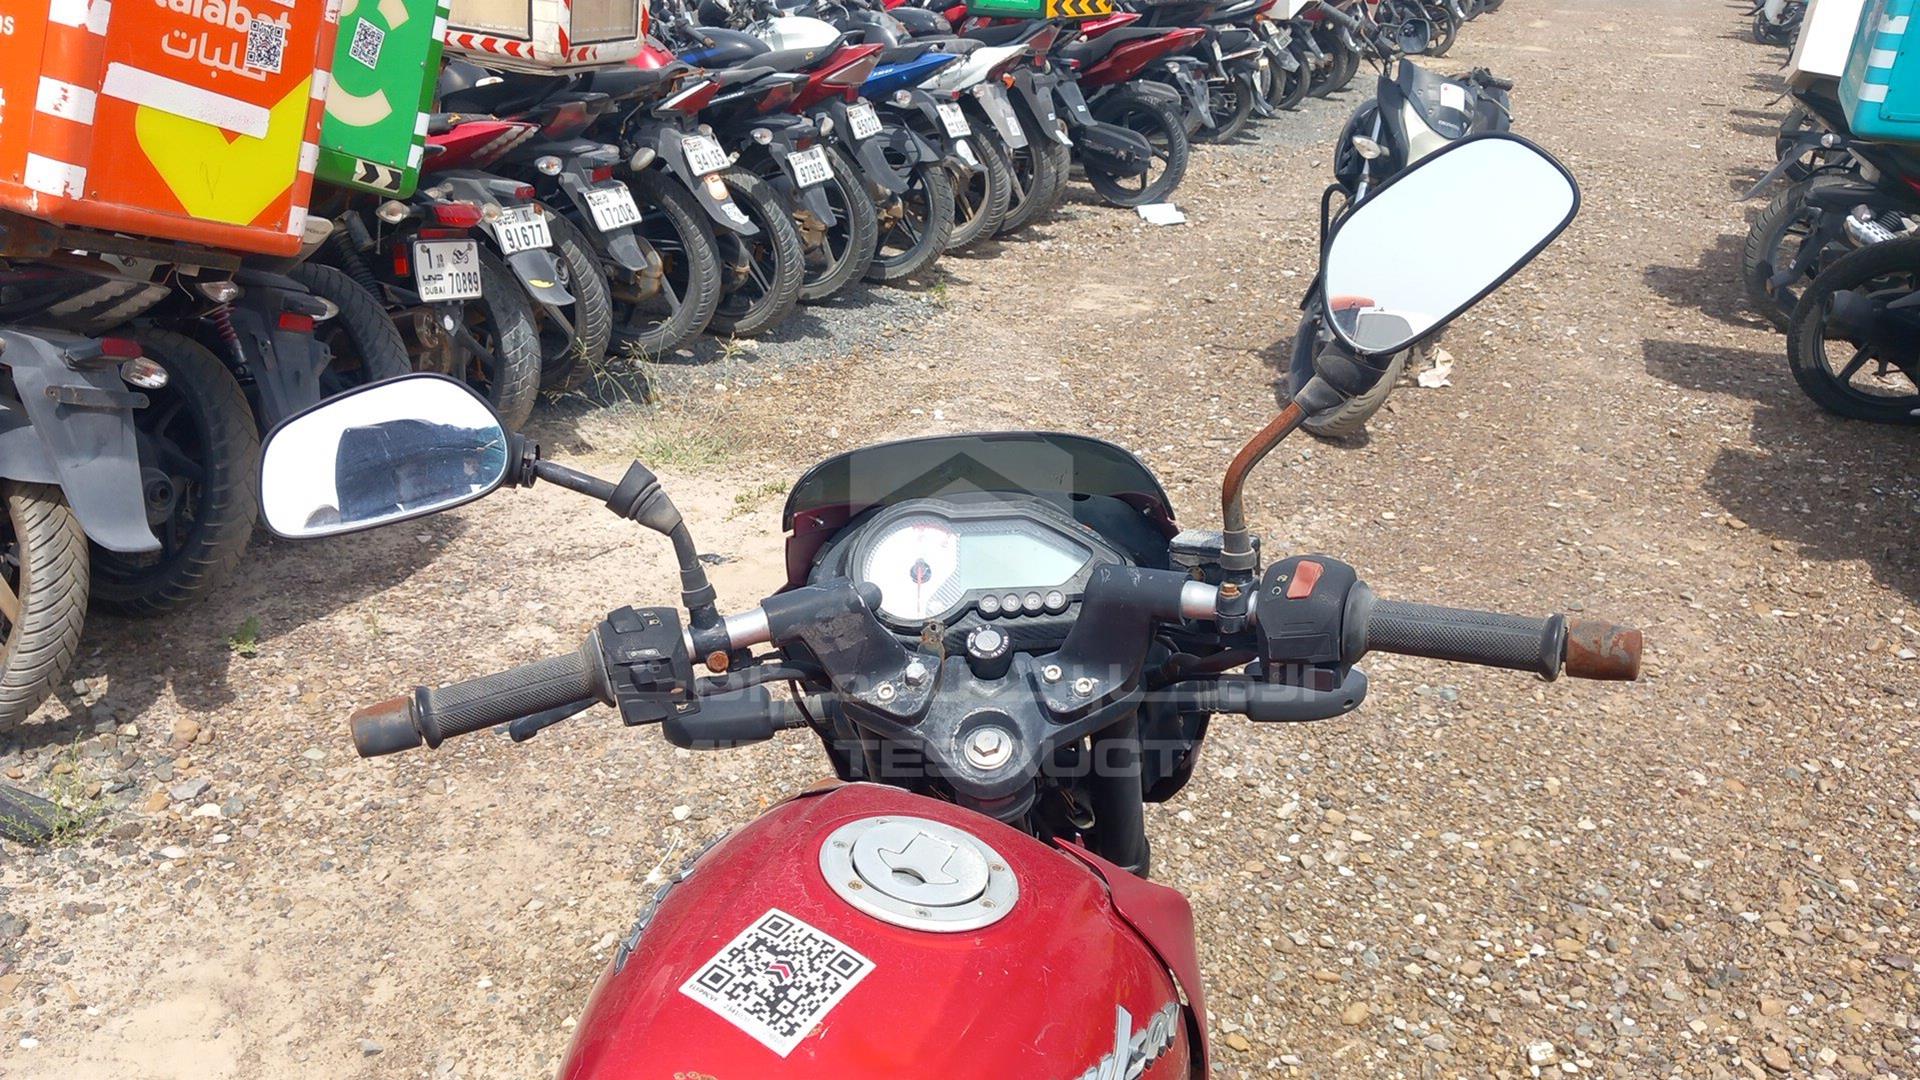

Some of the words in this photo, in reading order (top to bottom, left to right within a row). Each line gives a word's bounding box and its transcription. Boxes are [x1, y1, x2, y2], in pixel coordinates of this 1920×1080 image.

[600, 203, 635, 227] 17208
[505, 223, 544, 249] 91677
[425, 286, 446, 295] DUBAI
[448, 271, 479, 294] 70889
